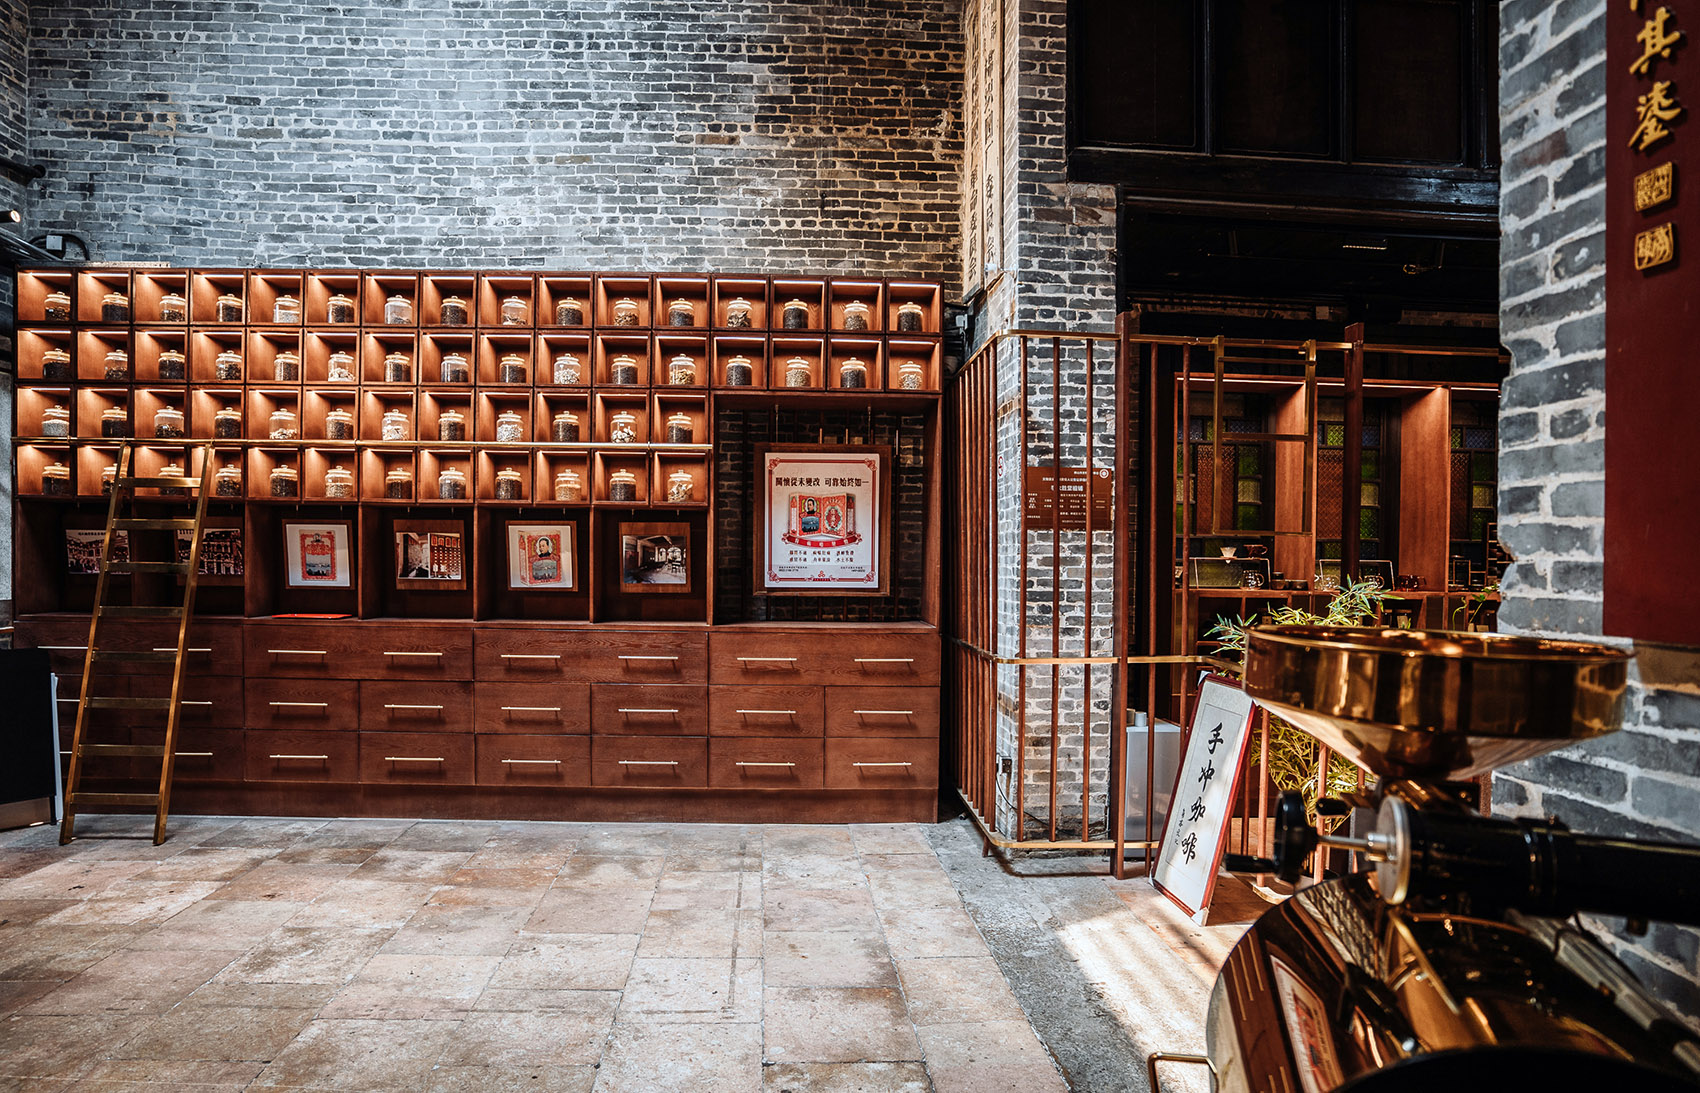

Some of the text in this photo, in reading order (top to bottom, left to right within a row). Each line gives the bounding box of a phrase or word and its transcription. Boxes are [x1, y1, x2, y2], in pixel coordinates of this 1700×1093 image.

[824, 477, 869, 487] 可靠始終如一
